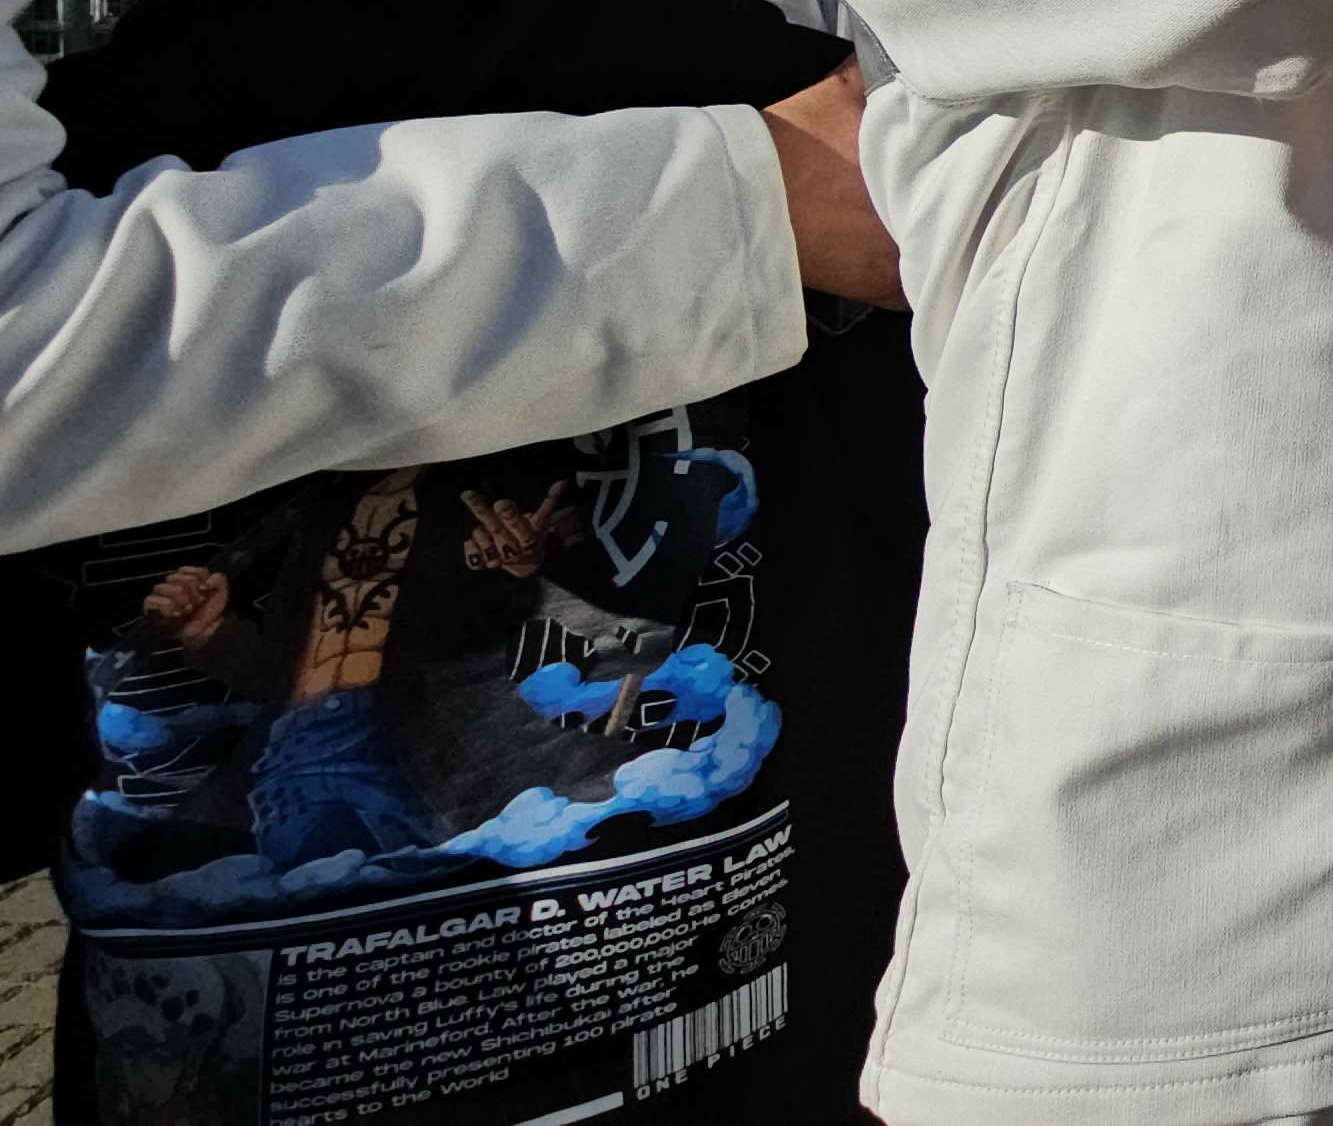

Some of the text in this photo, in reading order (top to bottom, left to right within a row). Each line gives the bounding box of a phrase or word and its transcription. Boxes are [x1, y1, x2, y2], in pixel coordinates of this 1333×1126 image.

[280, 823, 793, 967] TRAFALGAR D. WATER LAW
[302, 983, 349, 1001] one
[355, 973, 384, 992] of
[390, 967, 432, 985] the
[438, 949, 513, 974] rookie
[603, 907, 682, 940] labeled
[687, 899, 716, 917] as
[721, 868, 782, 905] Eleven
[306, 965, 349, 982] the
[355, 947, 446, 973] captain
[451, 932, 497, 955] and
[501, 919, 579, 944] doctor
[583, 910, 609, 928] of
[616, 902, 655, 921] the
[661, 880, 726, 907] Heart
[271, 1042, 318, 1058] role
[349, 1020, 430, 1048] saving
[525, 990, 560, 1009] life
[564, 969, 641, 999] during
[646, 955, 686, 975] the
[271, 1059, 321, 1077] war
[324, 1053, 353, 1070] at
[501, 1005, 564, 1031] After
[569, 993, 611, 1013] the
[671, 963, 701, 982] he
[272, 990, 405, 1024] Supernova
[434, 965, 518, 993] bounty
[525, 955, 550, 974] of
[273, 1022, 334, 1041] from
[339, 1006, 412, 1032] North
[478, 980, 528, 1001] Law
[533, 960, 609, 993] played
[634, 934, 702, 965] major
[269, 1069, 366, 1095] became
[372, 1058, 416, 1077] the
[420, 1044, 474, 1068] new
[618, 985, 678, 1016] after
[427, 1040, 558, 1086] presenting
[562, 1025, 605, 1048] 100
[610, 1001, 679, 1036] pirate
[636, 1015, 787, 1101] ONE PIECE
[391, 1088, 433, 1108] the
